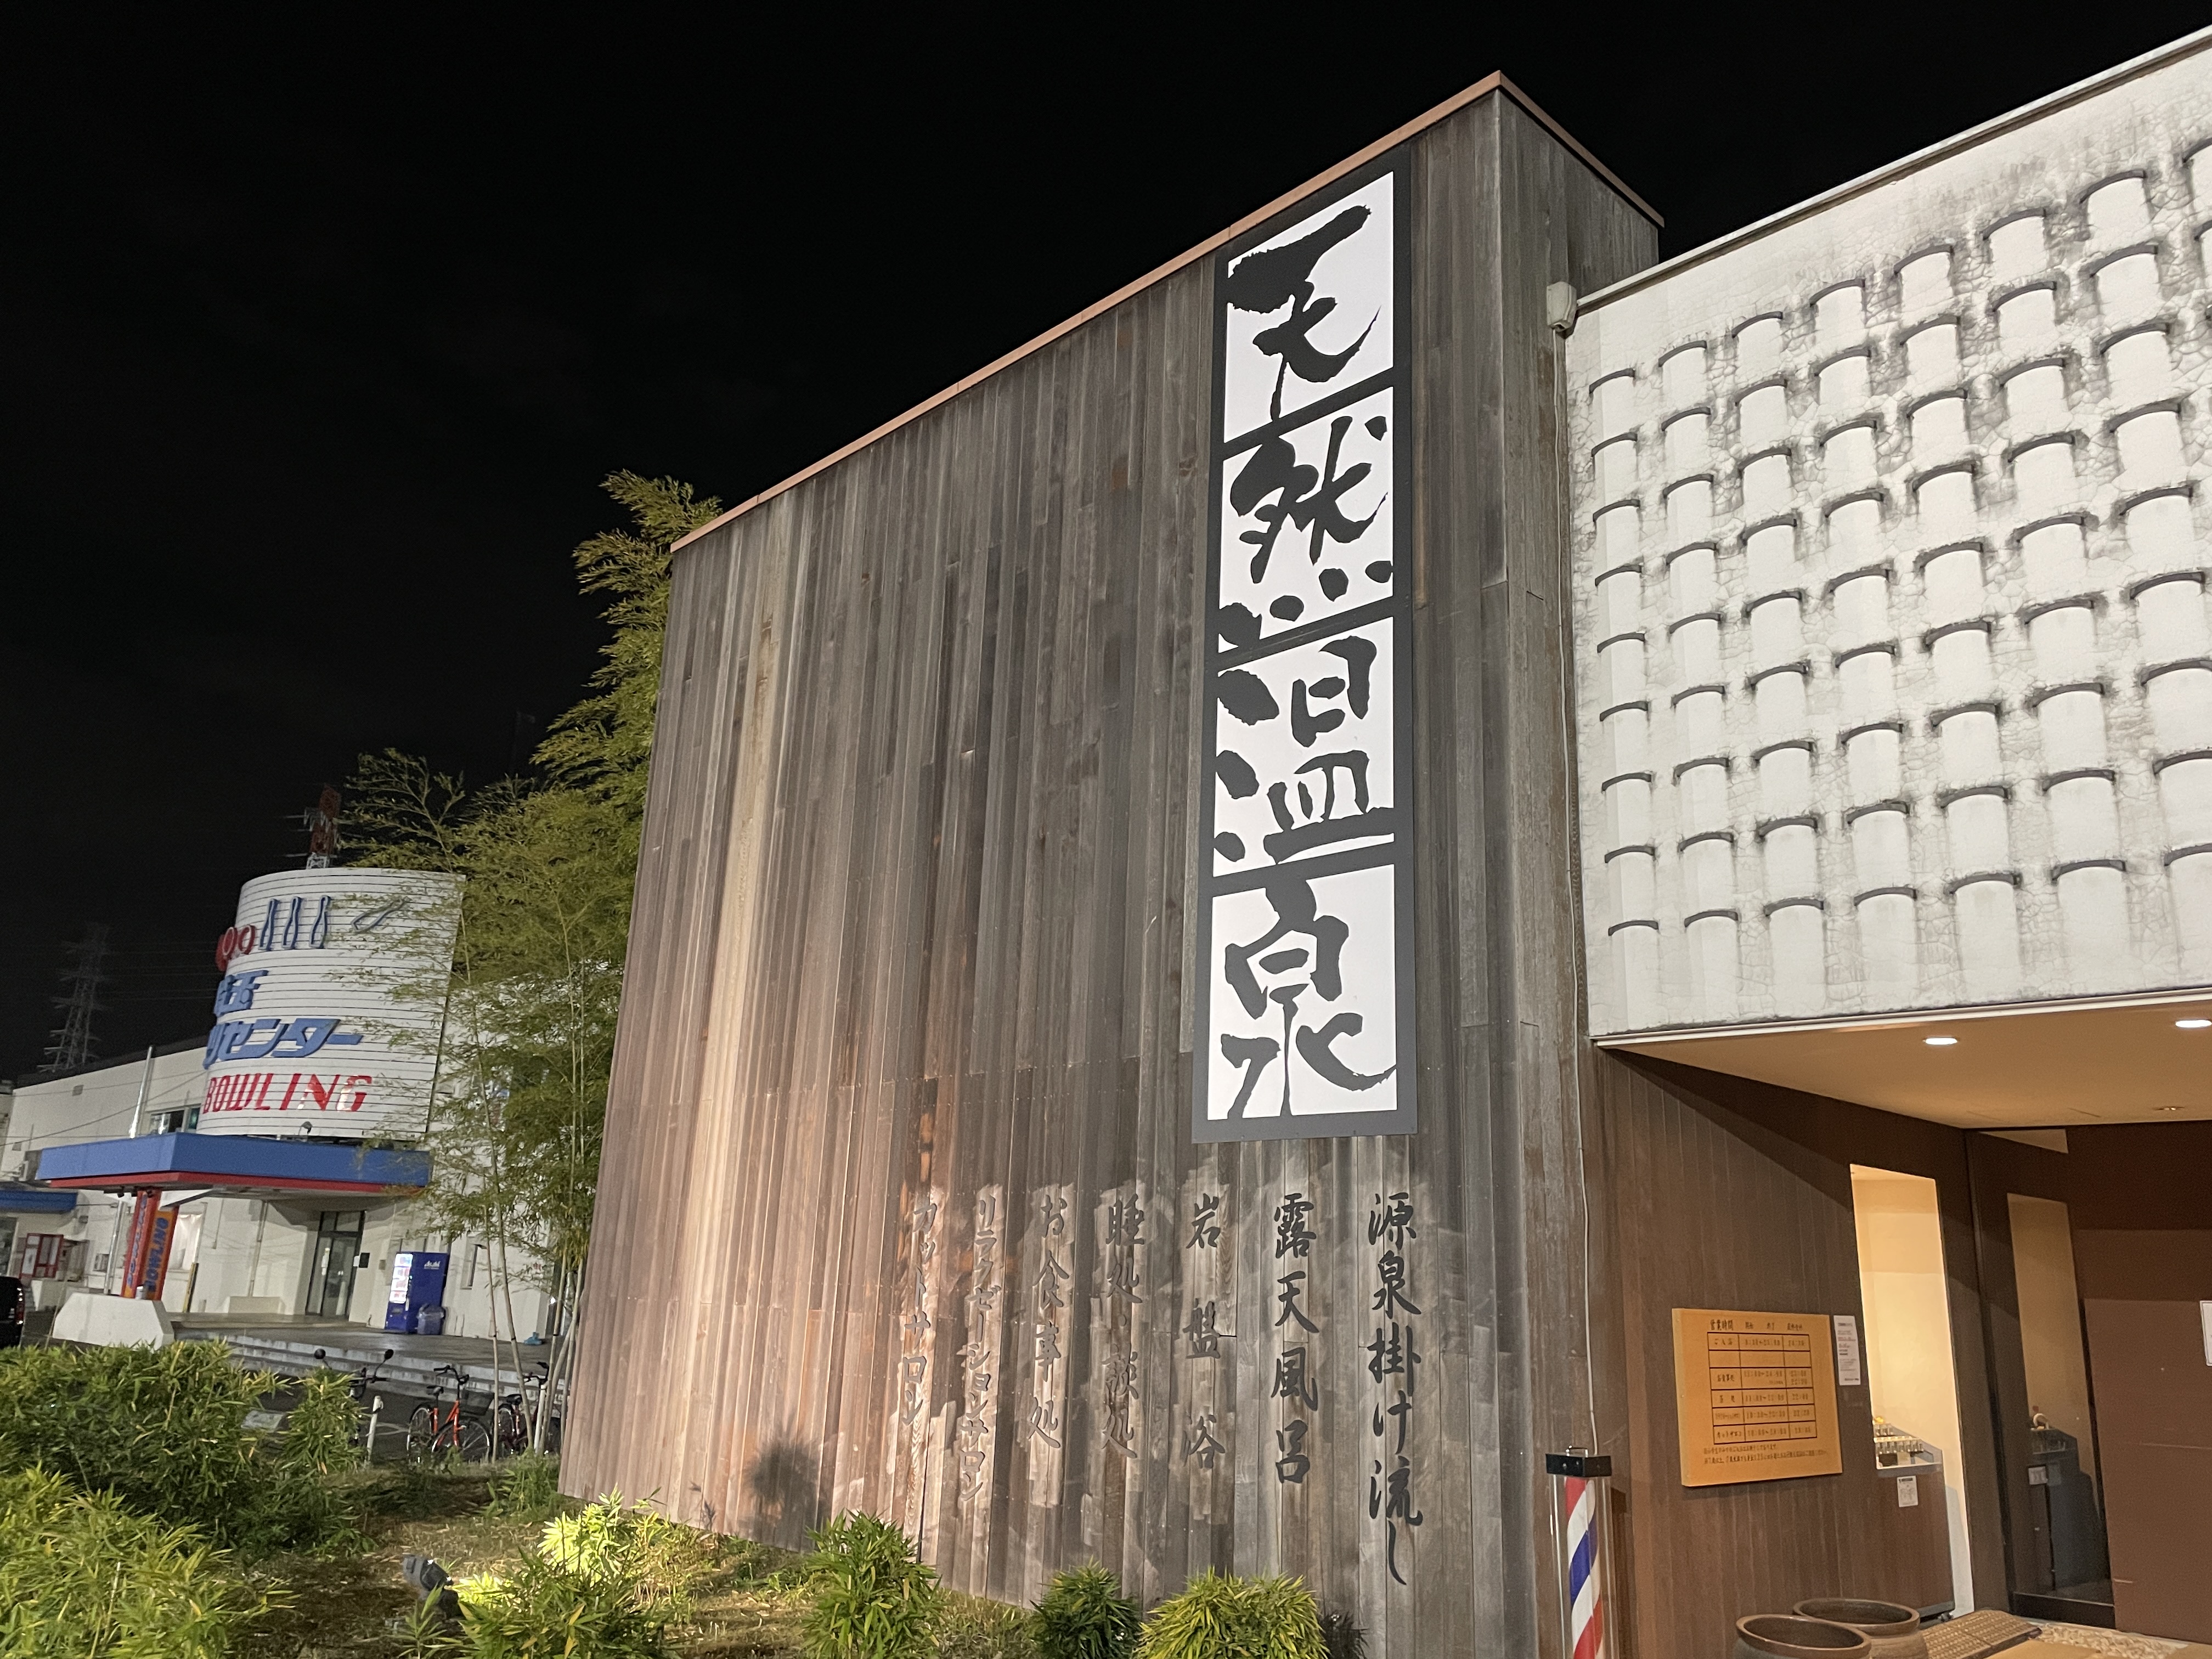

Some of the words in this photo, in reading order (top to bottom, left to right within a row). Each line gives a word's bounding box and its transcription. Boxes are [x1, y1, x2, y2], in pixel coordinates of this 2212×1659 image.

[1214, 203, 1398, 1119] 天然温泉
[202, 1073, 373, 1114] BOWLING
[902, 1203, 938, 1426] カットサロン
[960, 1194, 1001, 1502] リラクゼーションサロン
[1026, 1194, 1070, 1449] お食事処
[1180, 1193, 1226, 1469] 岩盤浴
[1271, 1193, 1319, 1485] 露天風呂
[1367, 1193, 1423, 1586] 源泉掛け流し
